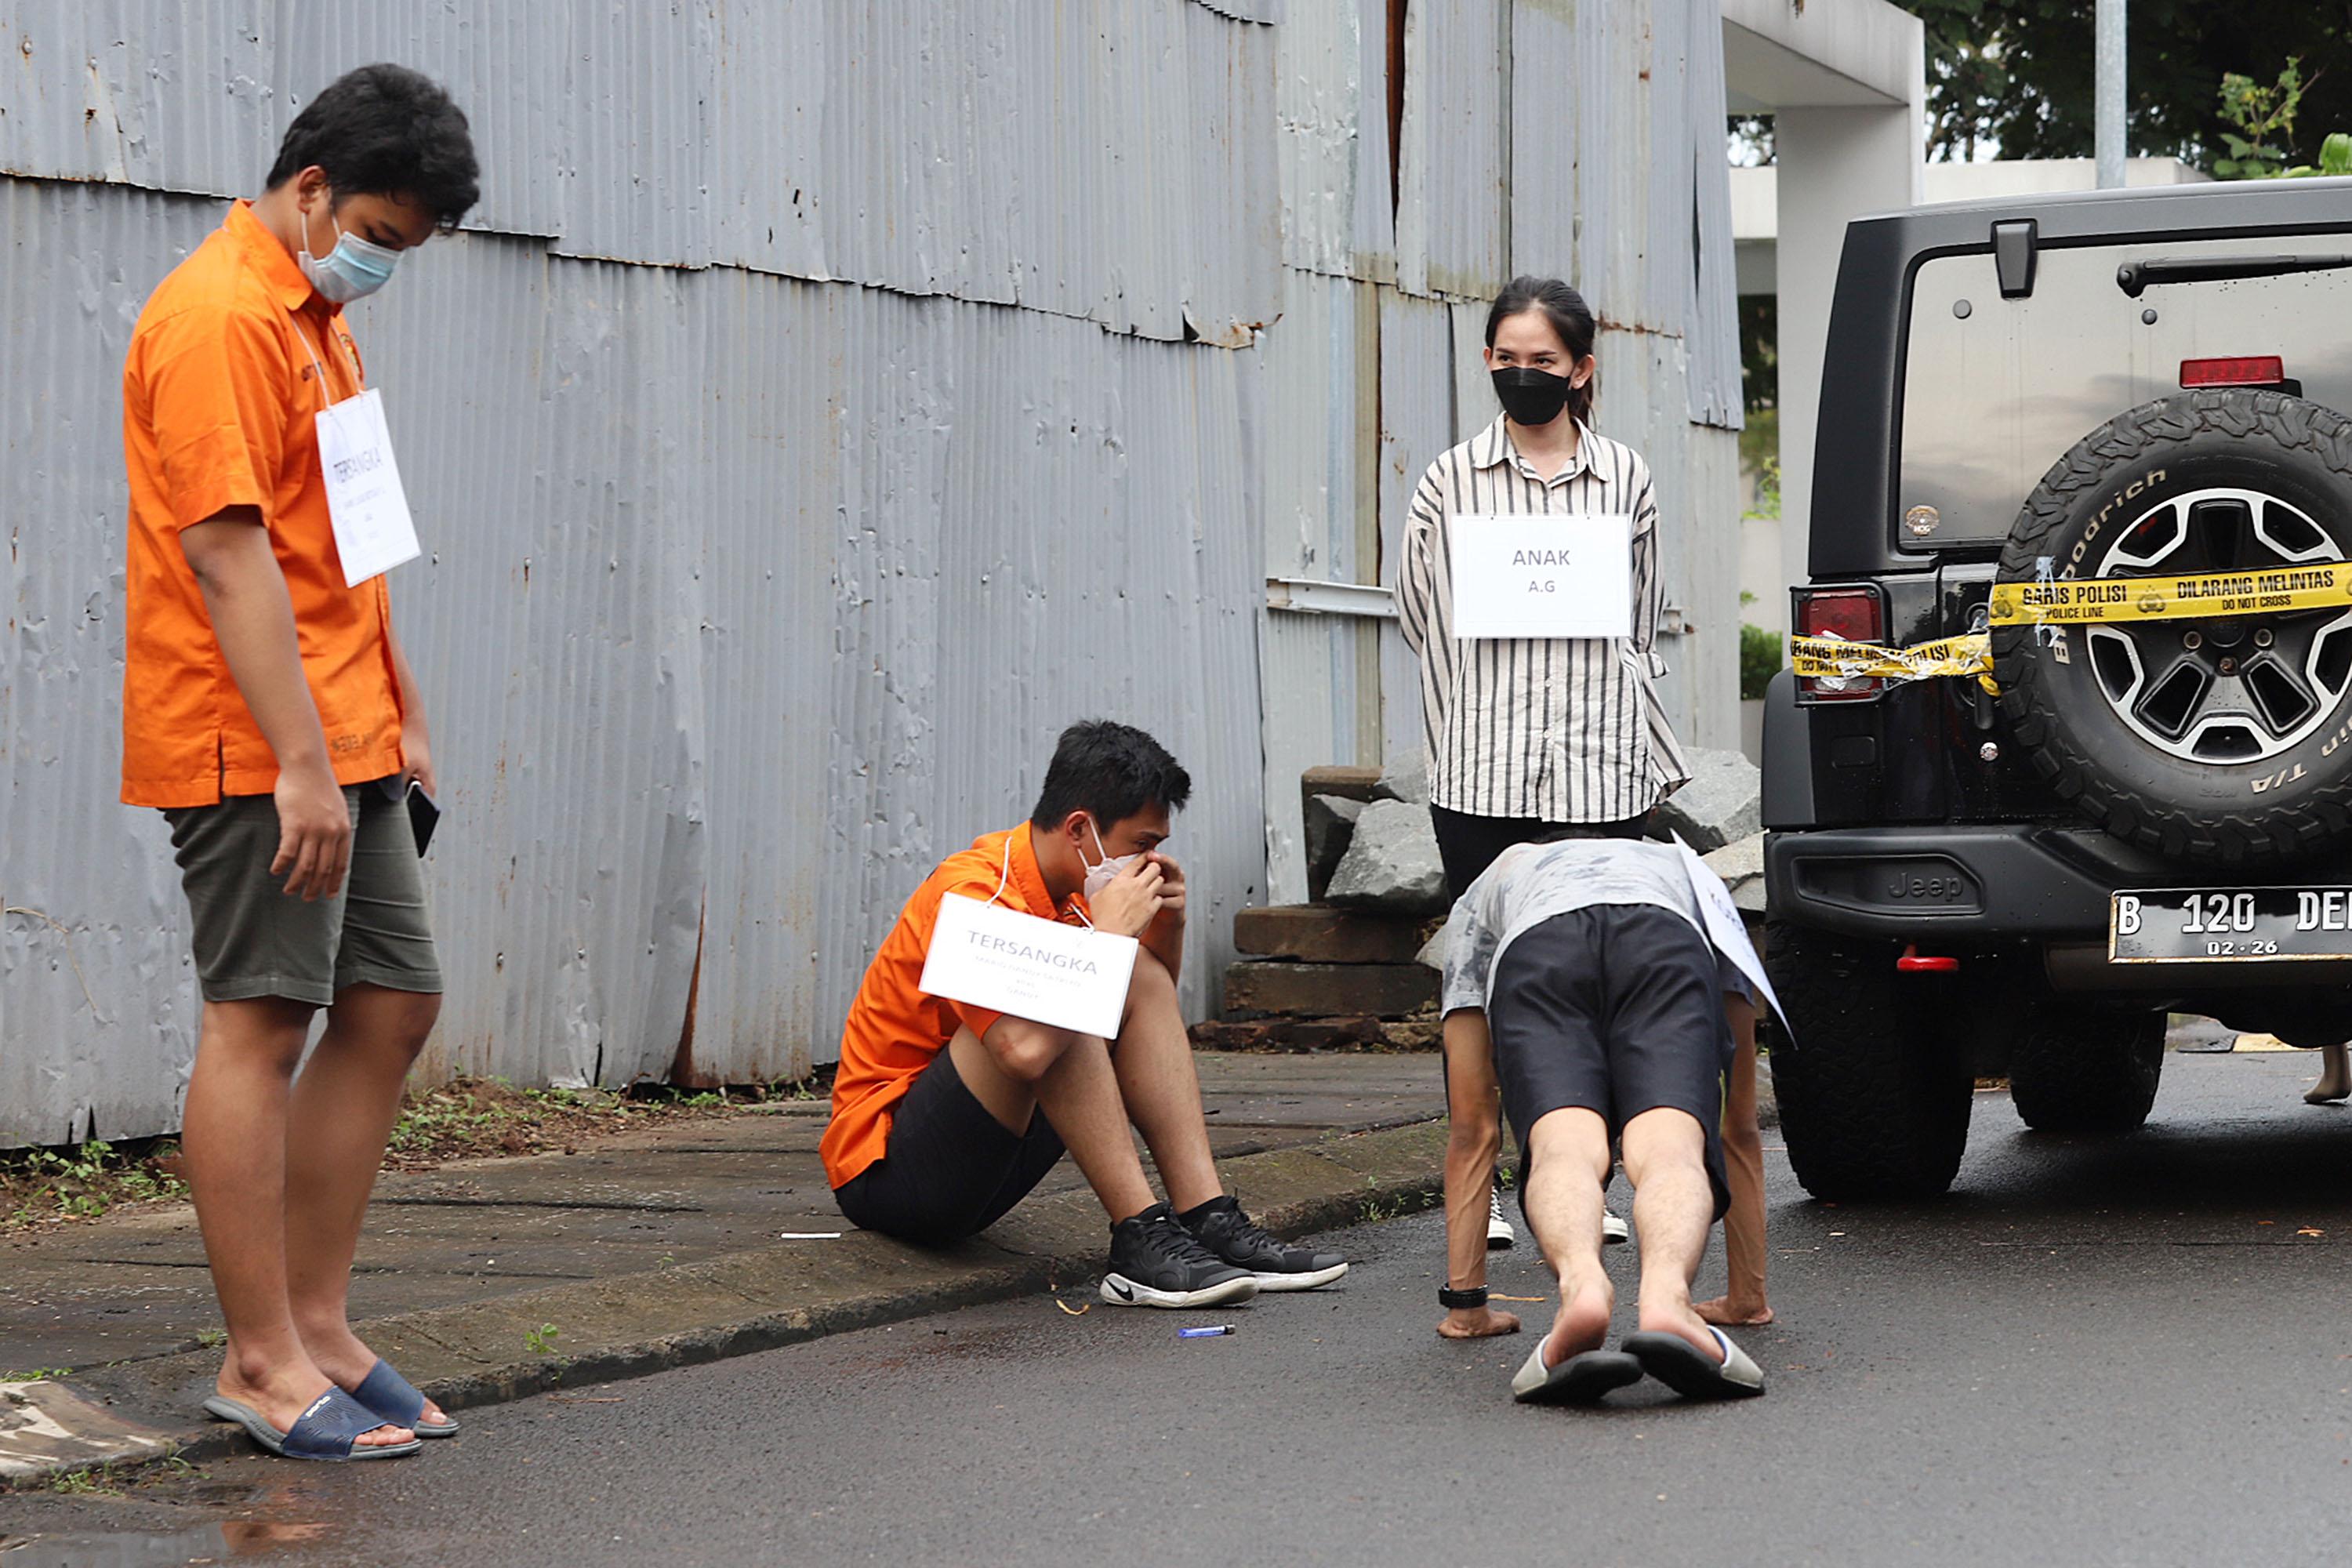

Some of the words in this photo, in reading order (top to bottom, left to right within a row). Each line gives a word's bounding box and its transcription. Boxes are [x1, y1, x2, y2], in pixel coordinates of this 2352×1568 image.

[1512, 550, 1570, 565] ANAK
[1528, 580, 1555, 593] A.G
[2023, 587, 2070, 605] GARIS
[2076, 585, 2127, 603] POLISI
[2177, 578, 2252, 598] DILARANG
[2259, 570, 2334, 590] MELINTAS
[2045, 608, 2080, 619] POLICE
[2082, 607, 2104, 618] LINE
[2222, 599, 2234, 610] DO
[2238, 597, 2256, 608] NOT
[2259, 595, 2292, 606] CROSS
[2250, 762, 2308, 794] T/A
[1889, 872, 1963, 902] Jeep
[2118, 895, 2142, 935] B
[2182, 893, 2255, 933] 120
[2296, 891, 2352, 931] DE
[967, 929, 1098, 975] TERSANGKA
